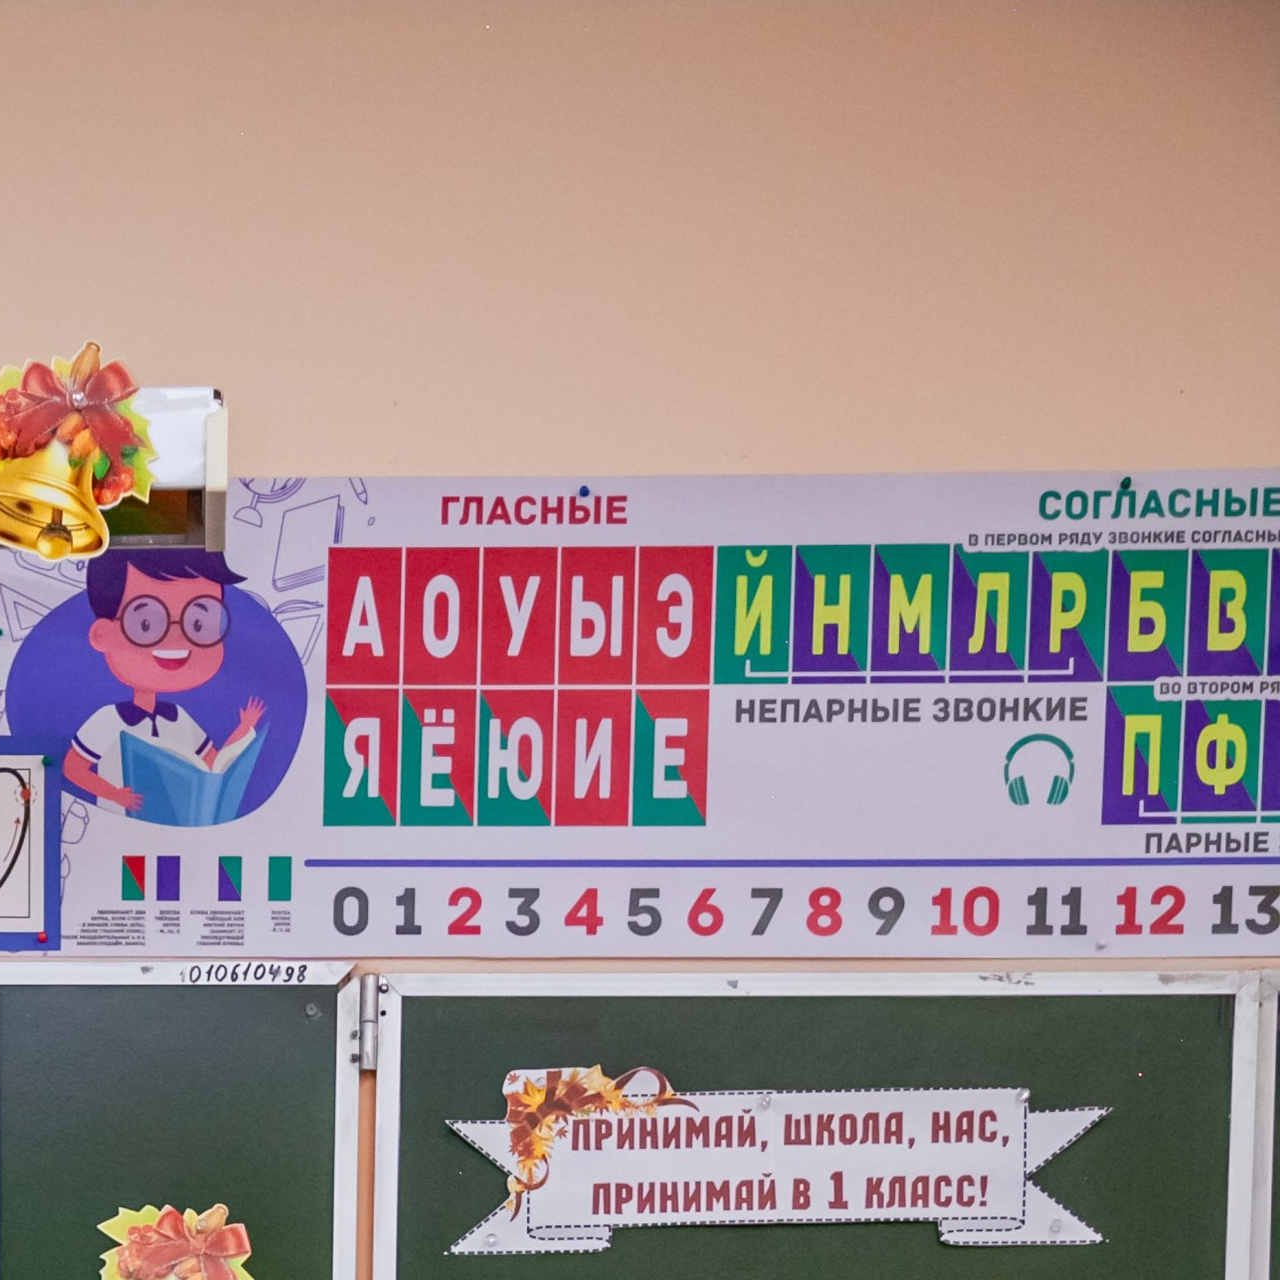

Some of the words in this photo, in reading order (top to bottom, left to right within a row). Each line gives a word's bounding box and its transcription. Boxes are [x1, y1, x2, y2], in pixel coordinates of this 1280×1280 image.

[440, 495, 628, 525] ГЛАСНЫЕ
[1038, 487, 1280, 520] СОГЛАСНЫЕ
[968, 534, 979, 546] В
[984, 533, 1053, 546] ПЕРВОМ
[1058, 531, 1103, 546] РЯДУ
[1108, 530, 1186, 544] ЗВОНКИЕ
[342, 576, 384, 656] А
[421, 574, 461, 658] О
[499, 576, 541, 656] У
[569, 576, 624, 656] Ы
[656, 573, 694, 658] Э
[734, 549, 773, 655] Й
[812, 574, 851, 655] Н
[888, 574, 932, 654] М
[968, 572, 1010, 654] Л
[1049, 572, 1087, 653] Р
[1127, 570, 1166, 652] Б
[1207, 570, 1247, 651] В
[1160, 682, 1181, 694] ВО
[1187, 681, 1254, 694] ВТОРОМ
[735, 698, 922, 723] НЕПАРНЫЕ
[932, 697, 1088, 722] ЗВОНКИЕ
[342, 717, 380, 797] Я
[421, 709, 455, 807] Ё
[487, 716, 543, 800] Ю
[574, 718, 612, 798] И
[652, 718, 688, 798] Е
[1122, 715, 1162, 796] П
[1195, 713, 1248, 795] Ф
[1145, 831, 1269, 854] ПАРНЫЕ
[333, 886, 369, 936] 0
[395, 887, 422, 936] 1
[447, 886, 482, 935] 2
[505, 887, 540, 936] 3
[564, 887, 604, 936] 4
[627, 887, 662, 936] 5
[687, 887, 724, 936] 6
[750, 887, 783, 935] 7
[806, 886, 843, 936] 8
[868, 886, 905, 935] 9
[931, 886, 1000, 936] 10
[1026, 886, 1087, 936] 11
[1115, 885, 1186, 935] 12
[1211, 885, 1280, 935] 13
[571, 1108, 769, 1153] ПРИНИМАЙ,
[783, 1111, 916, 1149] ШКОЛА,
[931, 1109, 1010, 1148] НАС,
[592, 1172, 777, 1215] ПРИНИМАЙ
[792, 1177, 811, 1210] В
[827, 1171, 849, 1210] 1
[865, 1175, 988, 1209] КЛАСС!
